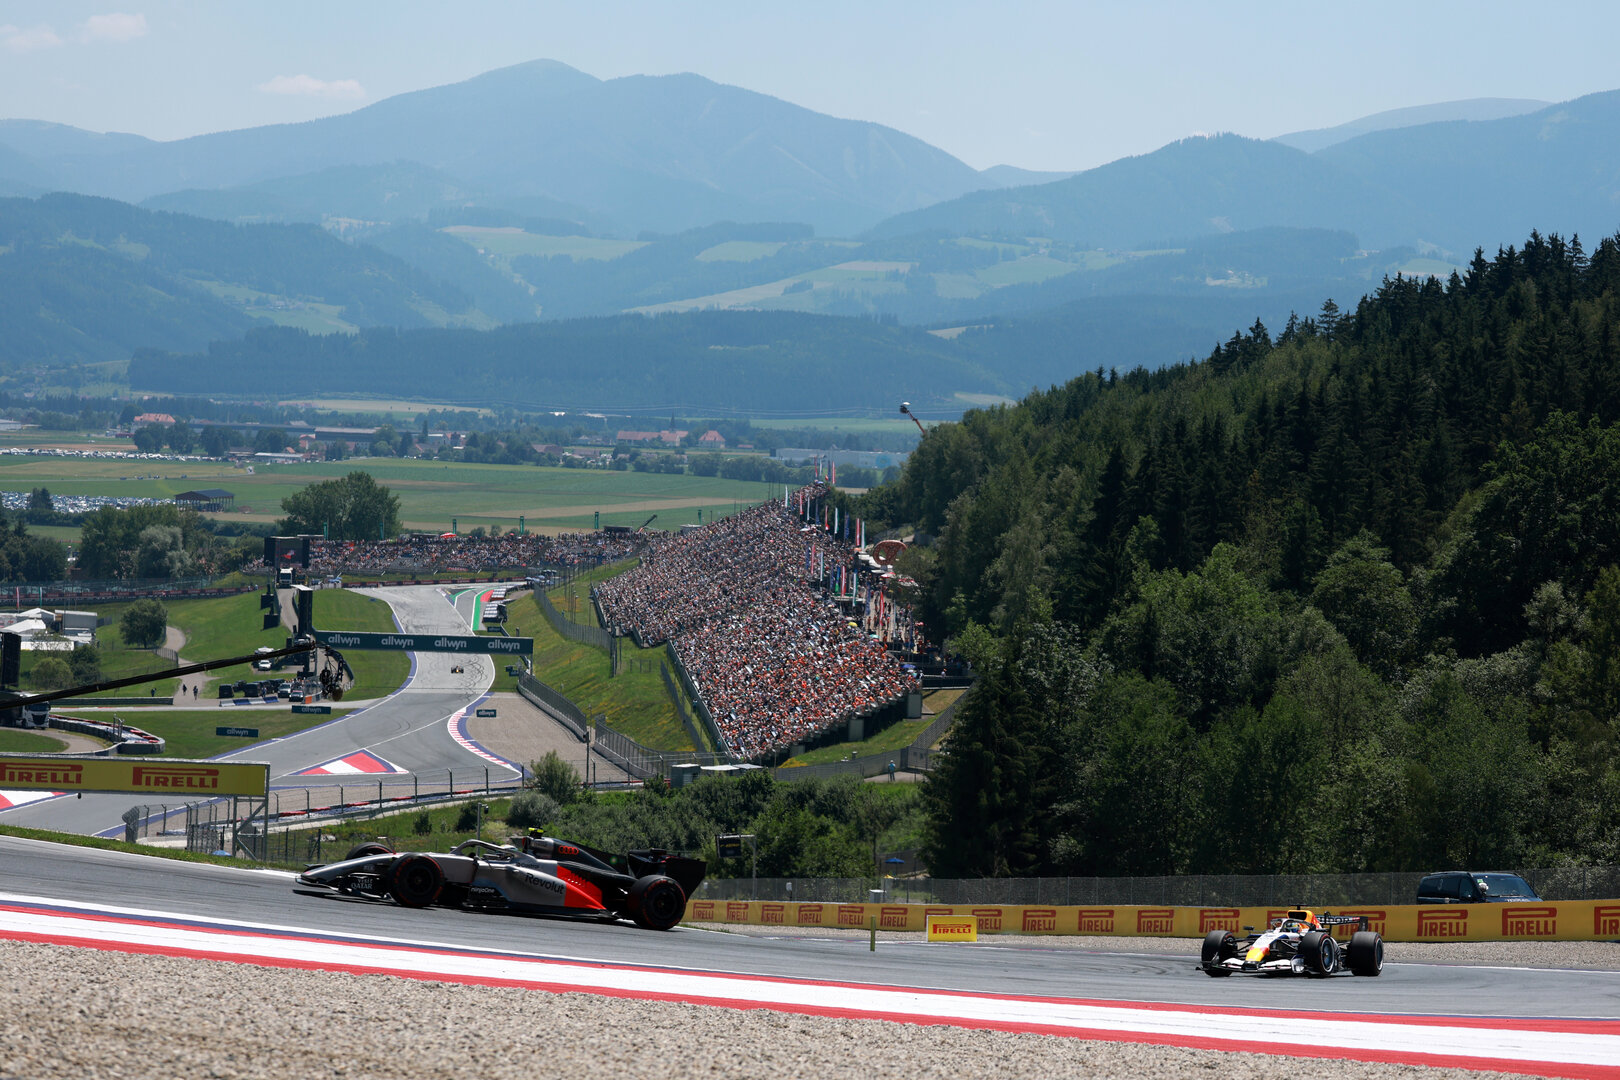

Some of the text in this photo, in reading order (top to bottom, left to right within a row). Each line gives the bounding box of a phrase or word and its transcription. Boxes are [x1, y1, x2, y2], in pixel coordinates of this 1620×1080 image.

[328, 634, 521, 651] allwyn allwyn allwyn allwyn
[0, 762, 219, 788] PIRELLI PIRELLI
[351, 882, 373, 890] QATAR
[525, 873, 565, 895] Revolut
[798, 904, 823, 924] PIRELLI
[838, 905, 865, 926] PIRELLI
[880, 907, 908, 928] PIRELLI
[1022, 910, 1056, 932] PIRELLI
[1078, 909, 1114, 933] PIRELLI
[1137, 909, 1174, 933] PIRELLI
[1199, 909, 1240, 933] PIRELLI
[1339, 911, 1387, 936] PIRLLI
[1417, 909, 1468, 937] PIRELLI
[1502, 907, 1557, 936] PIRELLI
[932, 924, 972, 934] PIRELLI
